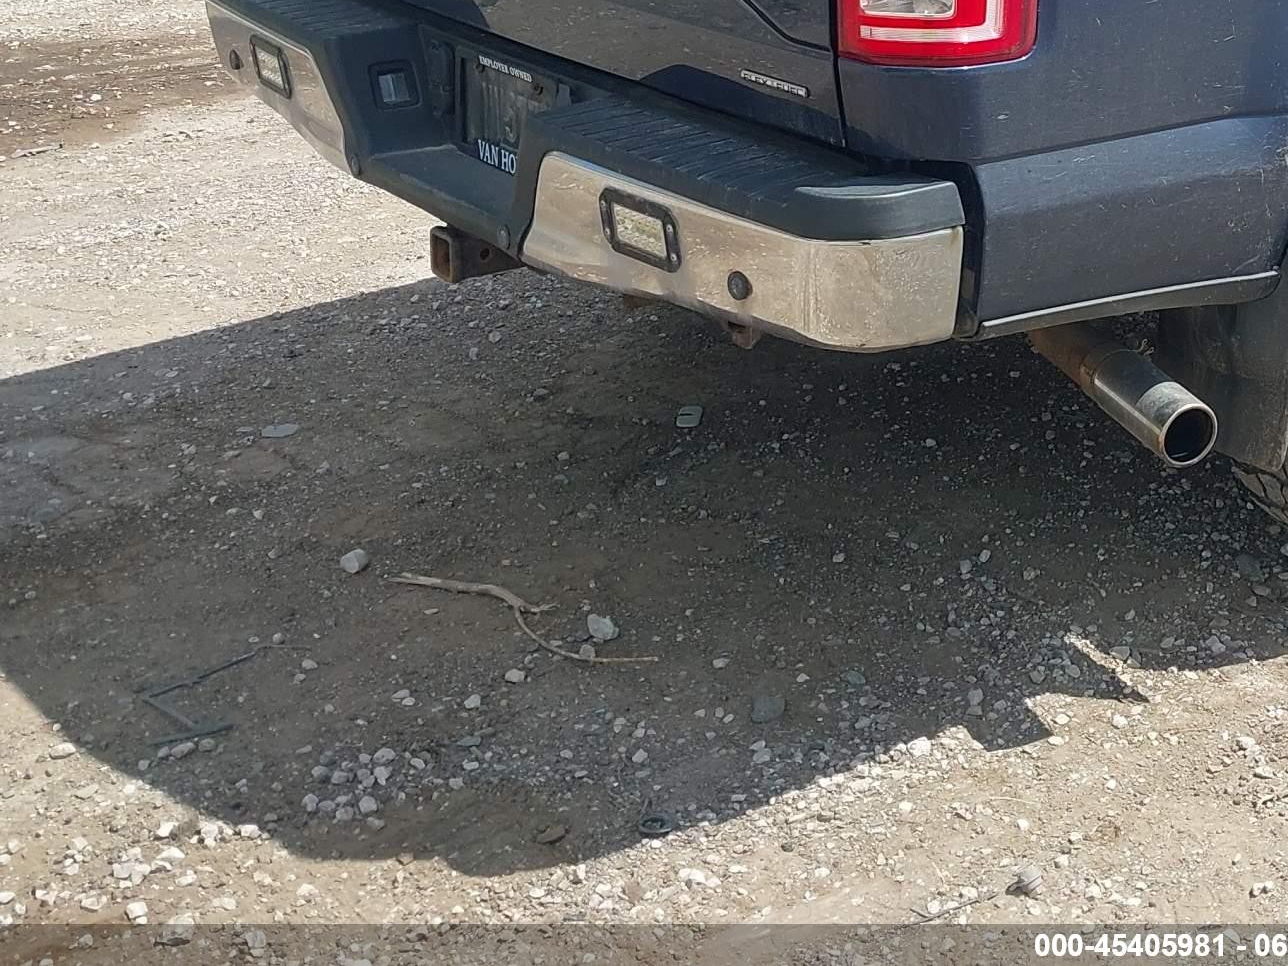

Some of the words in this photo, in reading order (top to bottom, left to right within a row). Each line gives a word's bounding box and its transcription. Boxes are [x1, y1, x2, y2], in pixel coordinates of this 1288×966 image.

[509, 66, 533, 83] OWNED
[478, 139, 499, 167] VAN
[501, 149, 518, 174] HO
